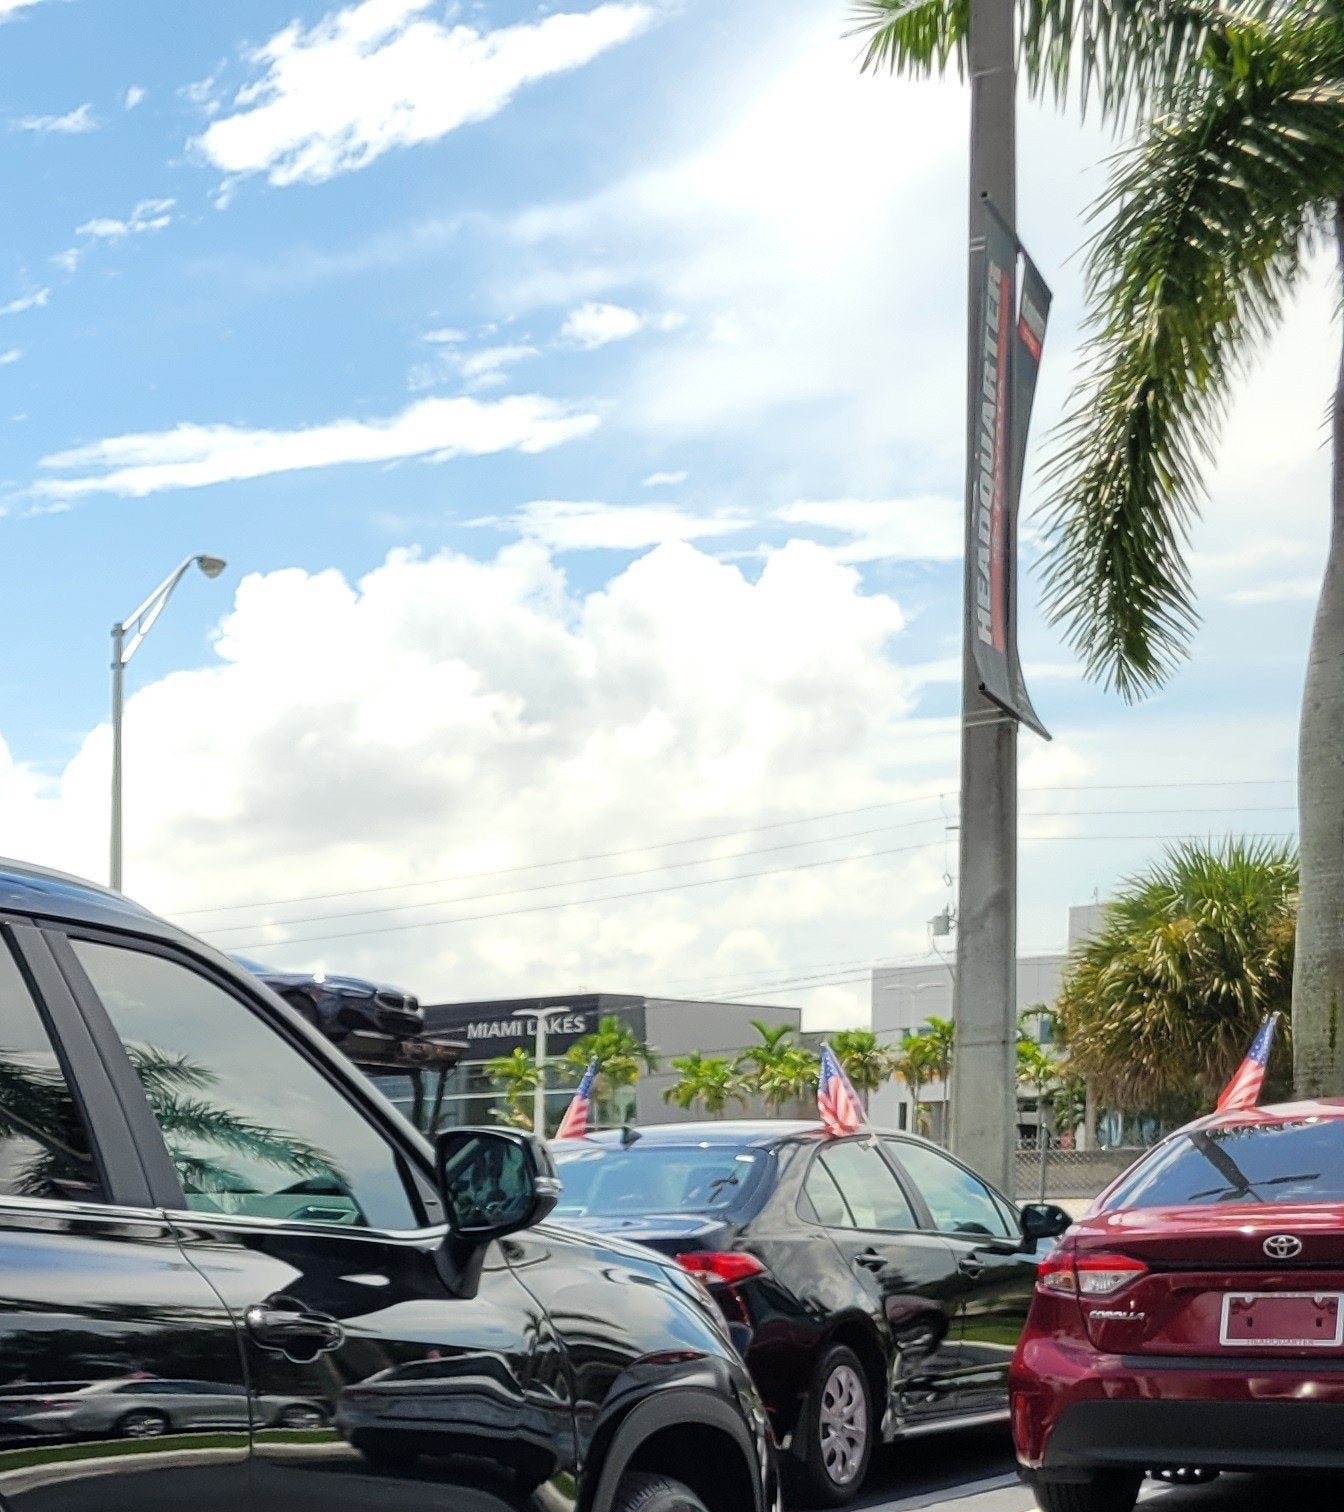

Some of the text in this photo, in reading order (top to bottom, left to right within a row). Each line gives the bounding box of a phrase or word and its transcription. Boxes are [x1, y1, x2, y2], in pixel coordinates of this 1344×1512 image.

[977, 261, 1003, 646] HEADQUARTER
[467, 1020, 523, 1039] MIAMI
[1089, 1310, 1145, 1320] COROLLA
